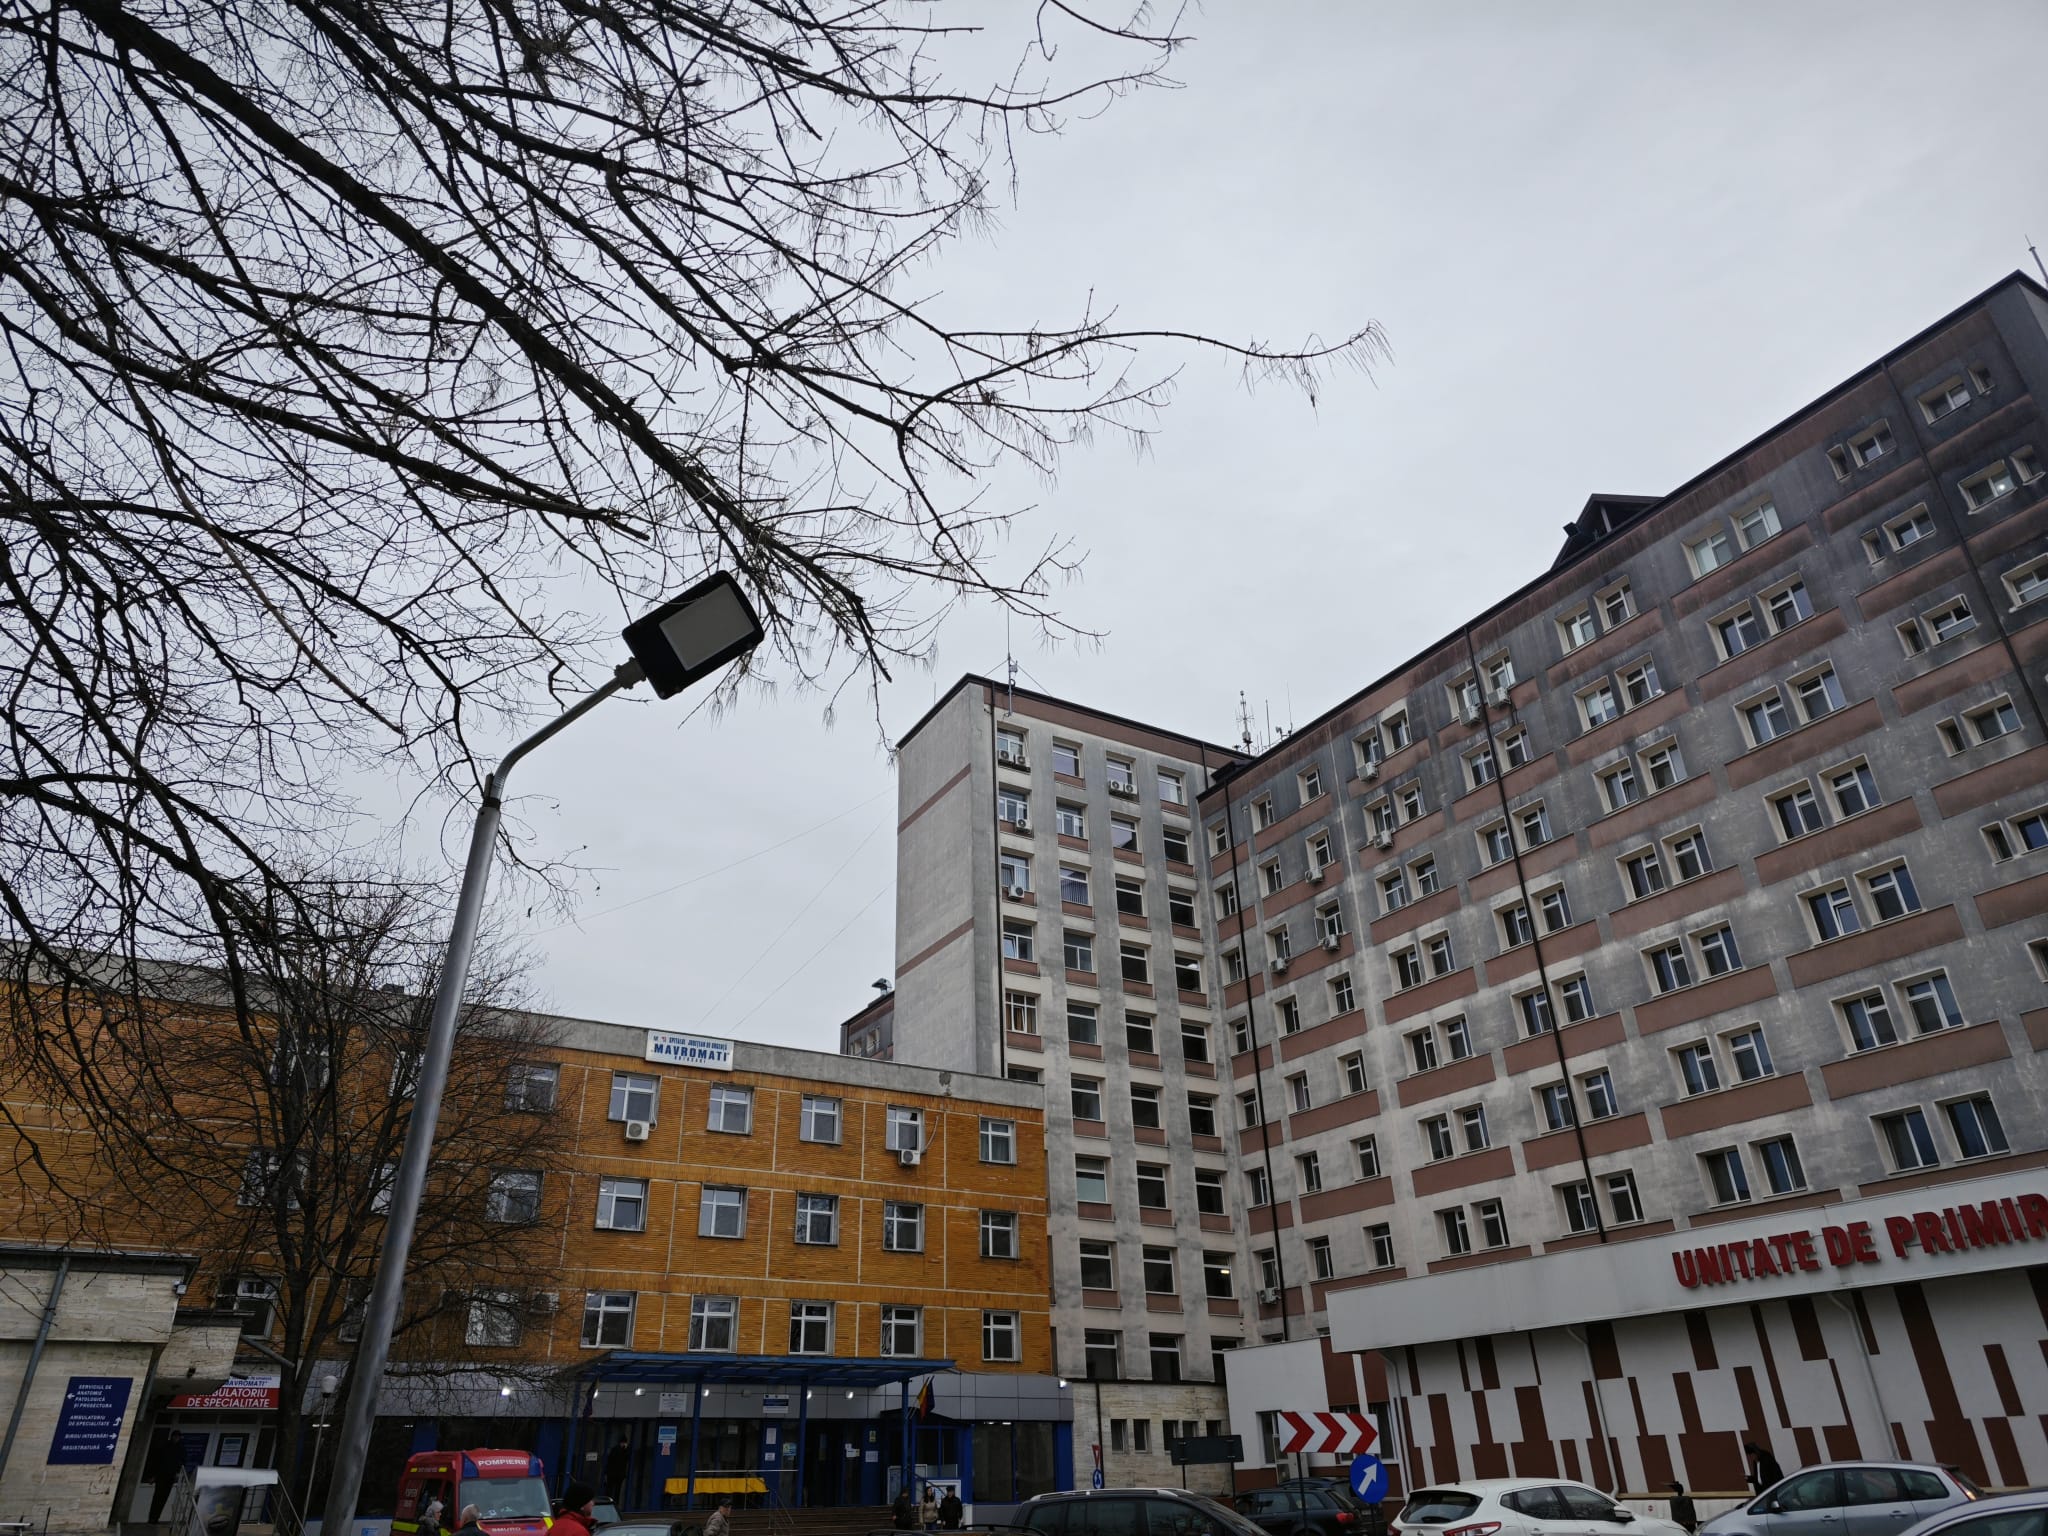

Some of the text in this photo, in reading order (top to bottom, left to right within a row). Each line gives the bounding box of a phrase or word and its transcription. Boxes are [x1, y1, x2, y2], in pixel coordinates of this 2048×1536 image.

[1671, 1193, 2048, 1288] UNITATE DE PRIMIR
[187, 1398, 270, 1408] DE SPECIALITATE
[478, 1458, 527, 1467] POMPIERII
